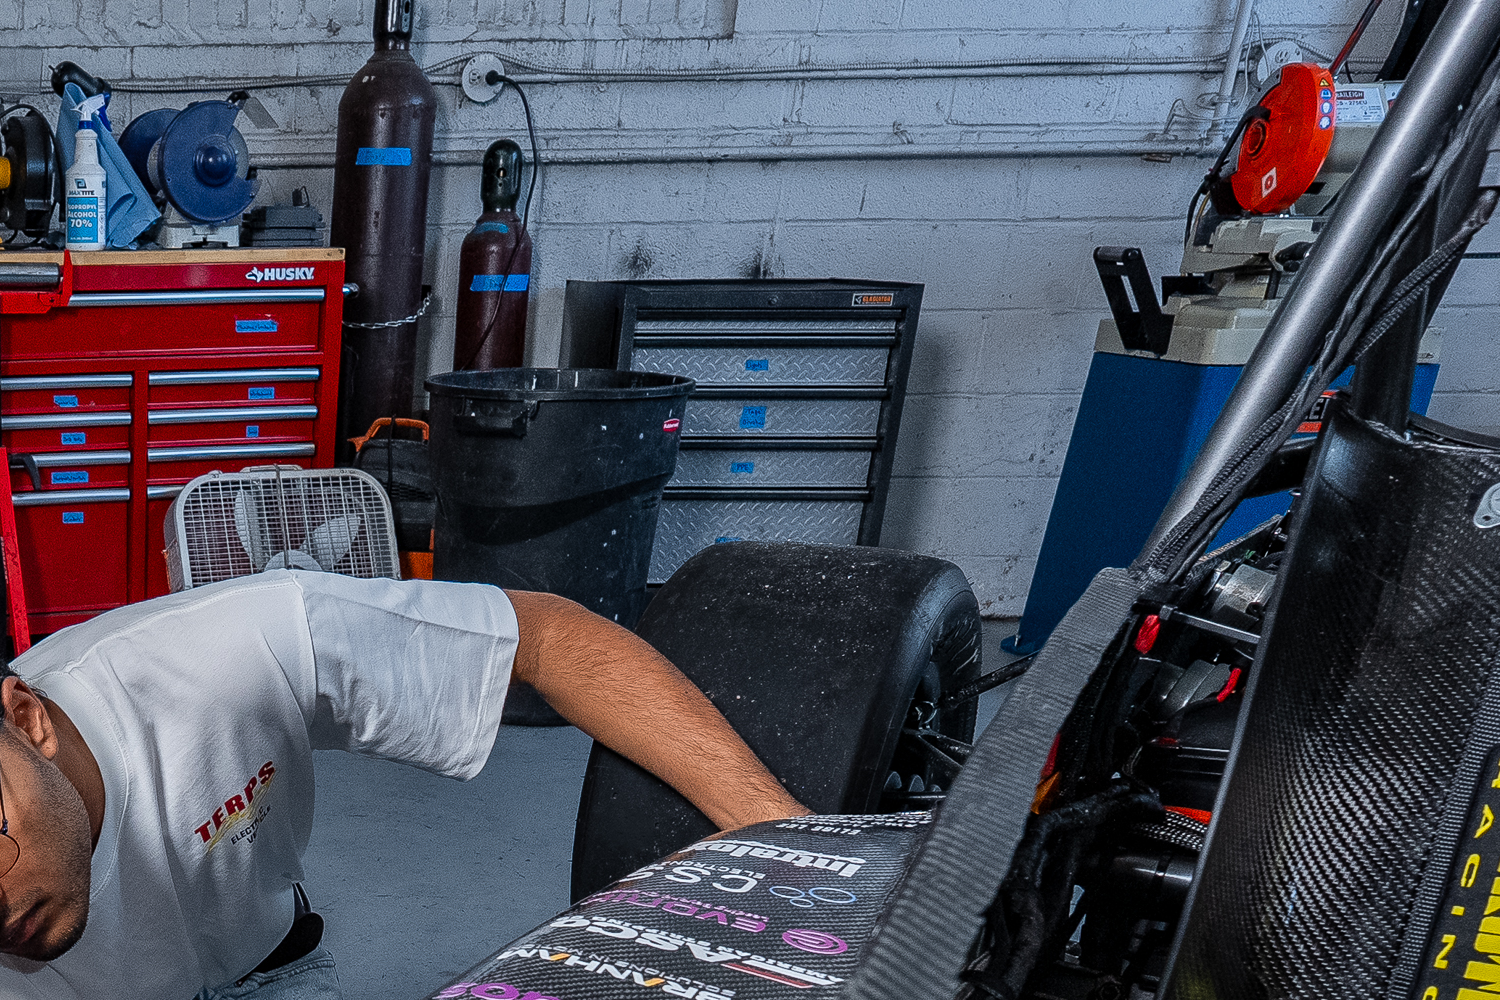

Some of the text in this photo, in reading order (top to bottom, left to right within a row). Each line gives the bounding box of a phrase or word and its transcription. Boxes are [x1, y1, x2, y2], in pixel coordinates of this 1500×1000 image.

[70, 219, 93, 227] 70%
[263, 267, 314, 280] HUSKY
[194, 760, 276, 843] TERPS
[614, 960, 737, 997] SOLUTIONS
[716, 944, 845, 983] AMERICAN
